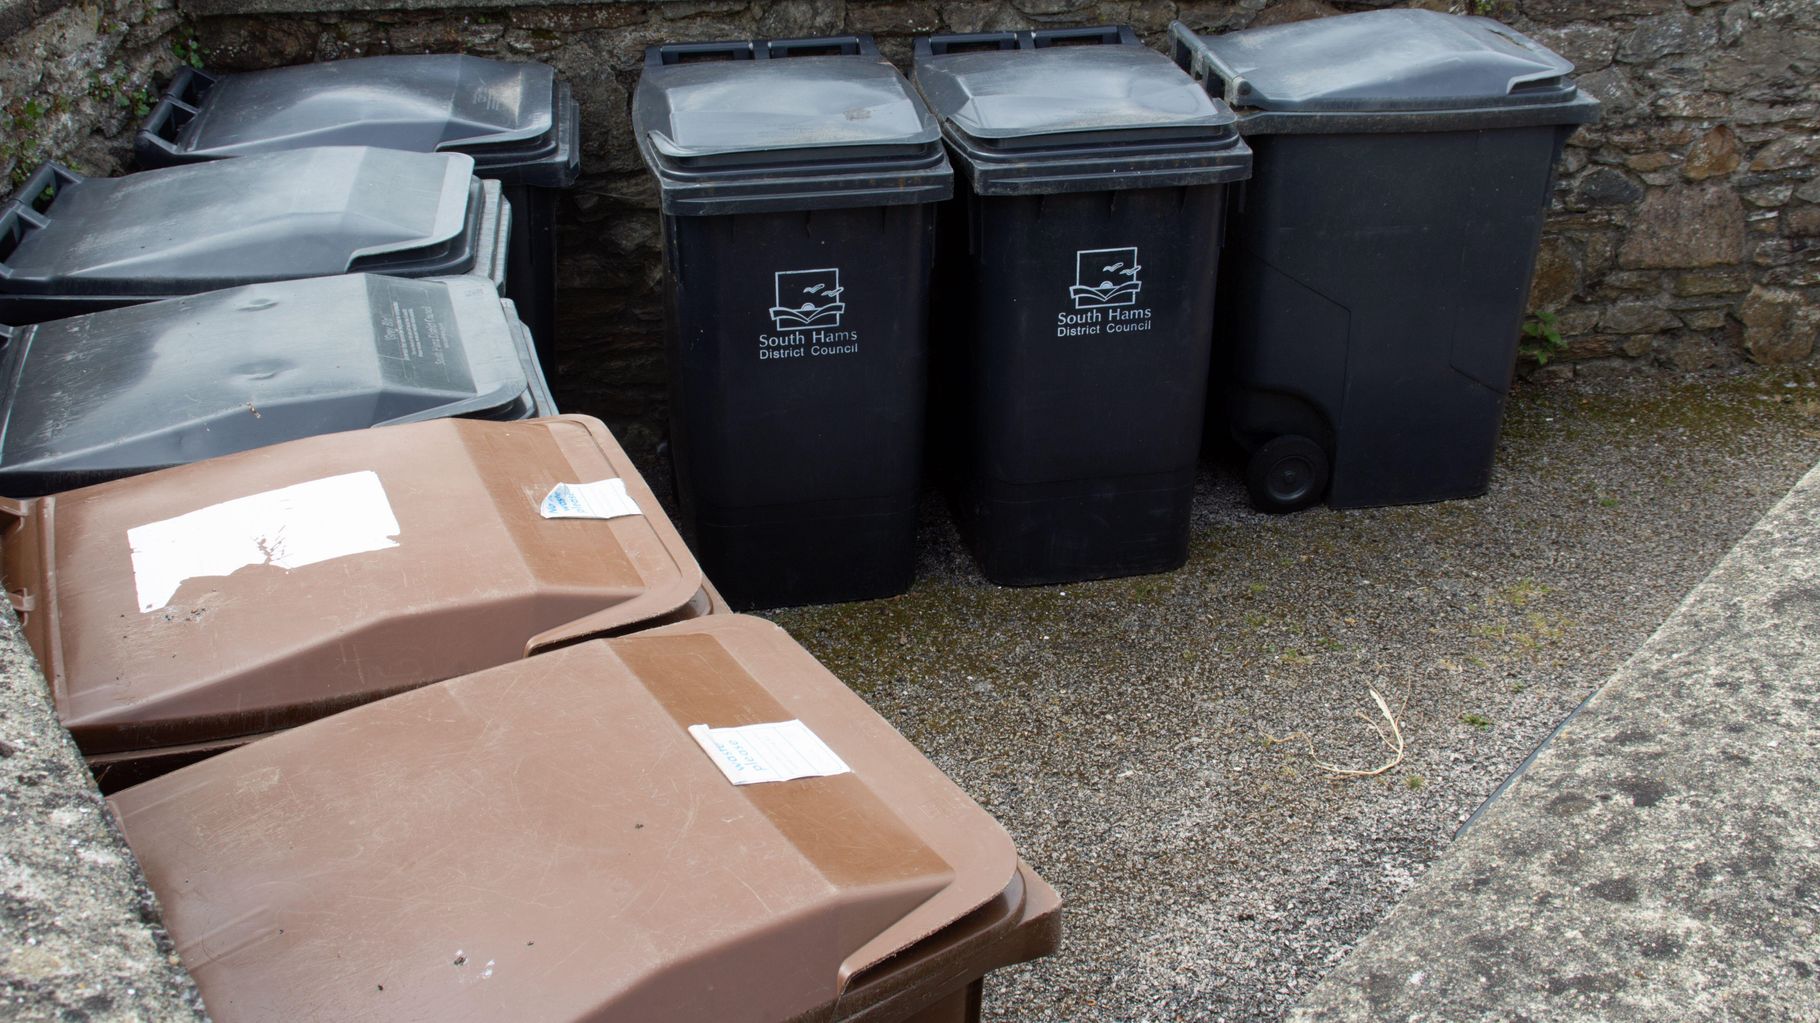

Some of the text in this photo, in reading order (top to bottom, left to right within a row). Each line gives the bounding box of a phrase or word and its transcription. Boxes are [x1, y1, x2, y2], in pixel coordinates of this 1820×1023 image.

[1057, 308, 1152, 325] South Hams
[1057, 320, 1152, 337] District Council
[759, 329, 858, 348] South Hams
[759, 343, 858, 360] District Council
[728, 739, 768, 772] please
